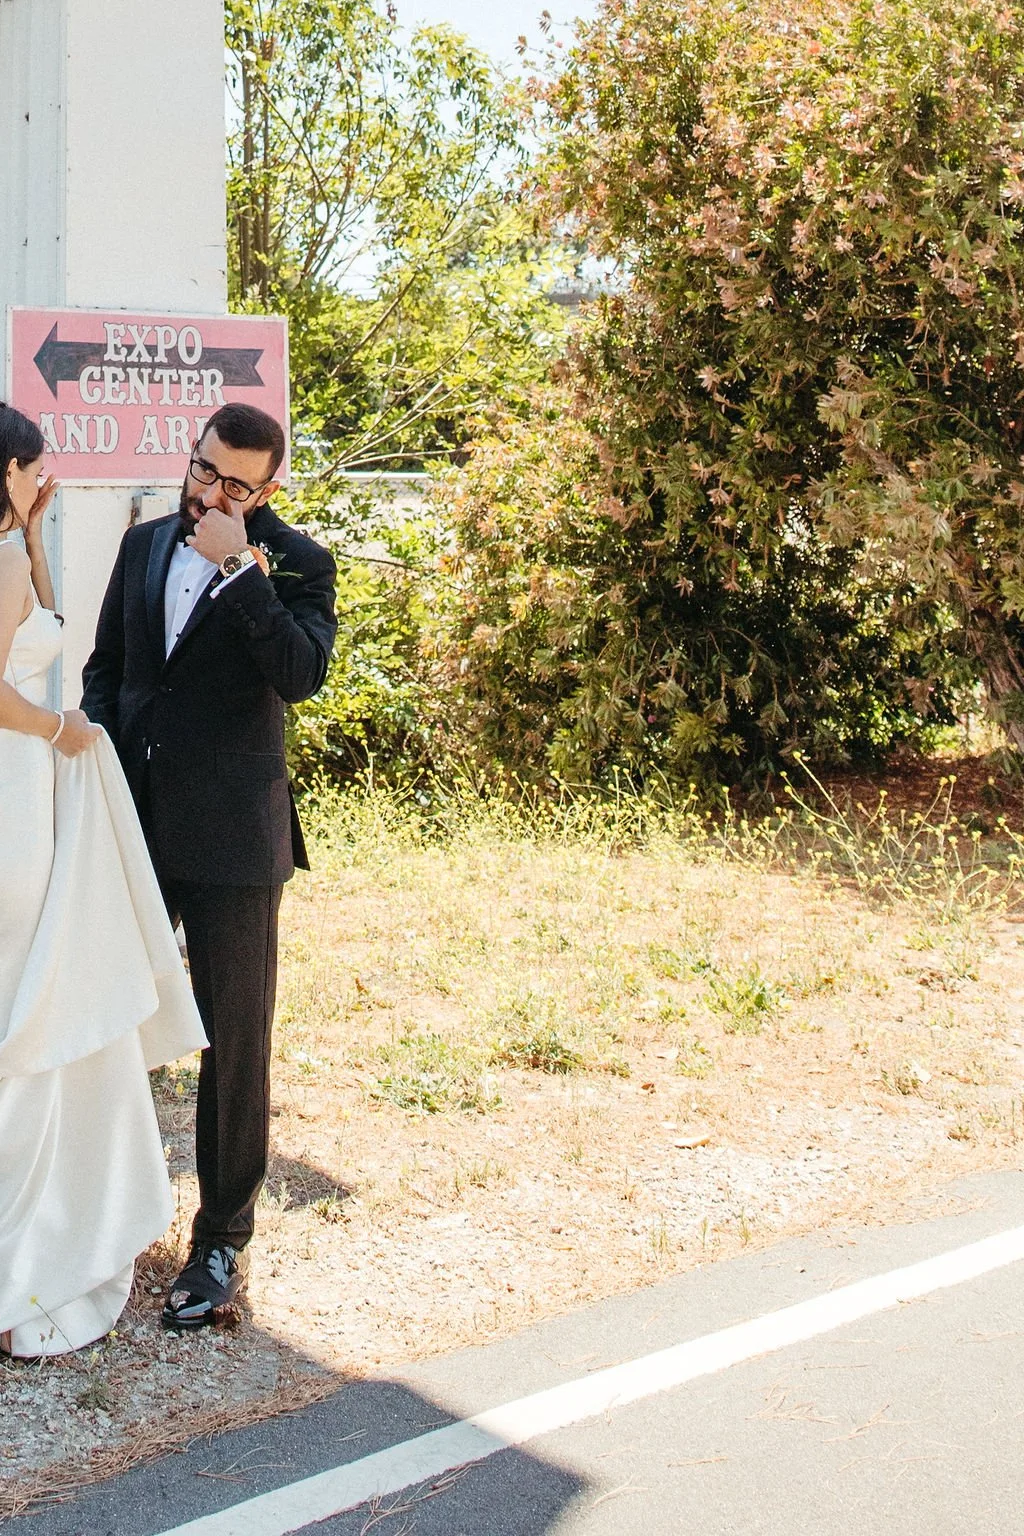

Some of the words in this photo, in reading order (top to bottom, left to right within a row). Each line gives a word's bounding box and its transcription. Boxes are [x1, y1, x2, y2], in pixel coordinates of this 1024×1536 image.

[103, 321, 204, 366] EXPO
[78, 364, 227, 408] CENTER
[39, 411, 120, 455] AND
